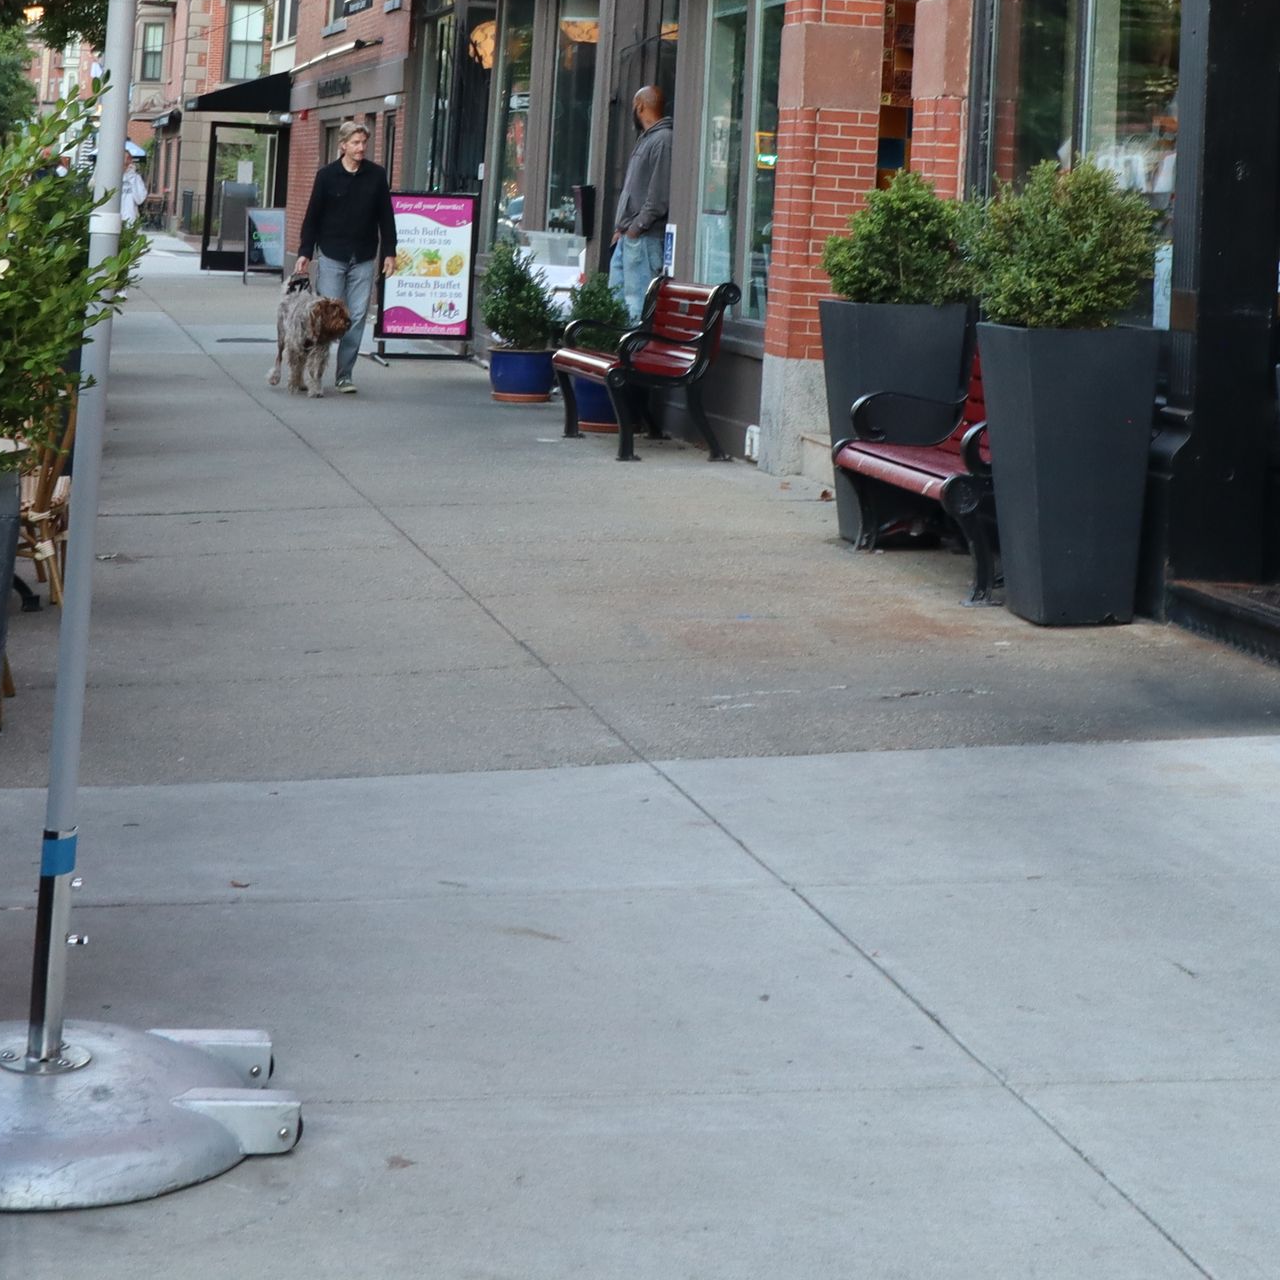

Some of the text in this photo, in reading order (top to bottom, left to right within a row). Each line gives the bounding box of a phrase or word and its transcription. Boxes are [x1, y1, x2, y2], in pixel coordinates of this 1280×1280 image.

[398, 227, 448, 236] unch Buffet
[397, 279, 461, 290] Brunch Buffet
